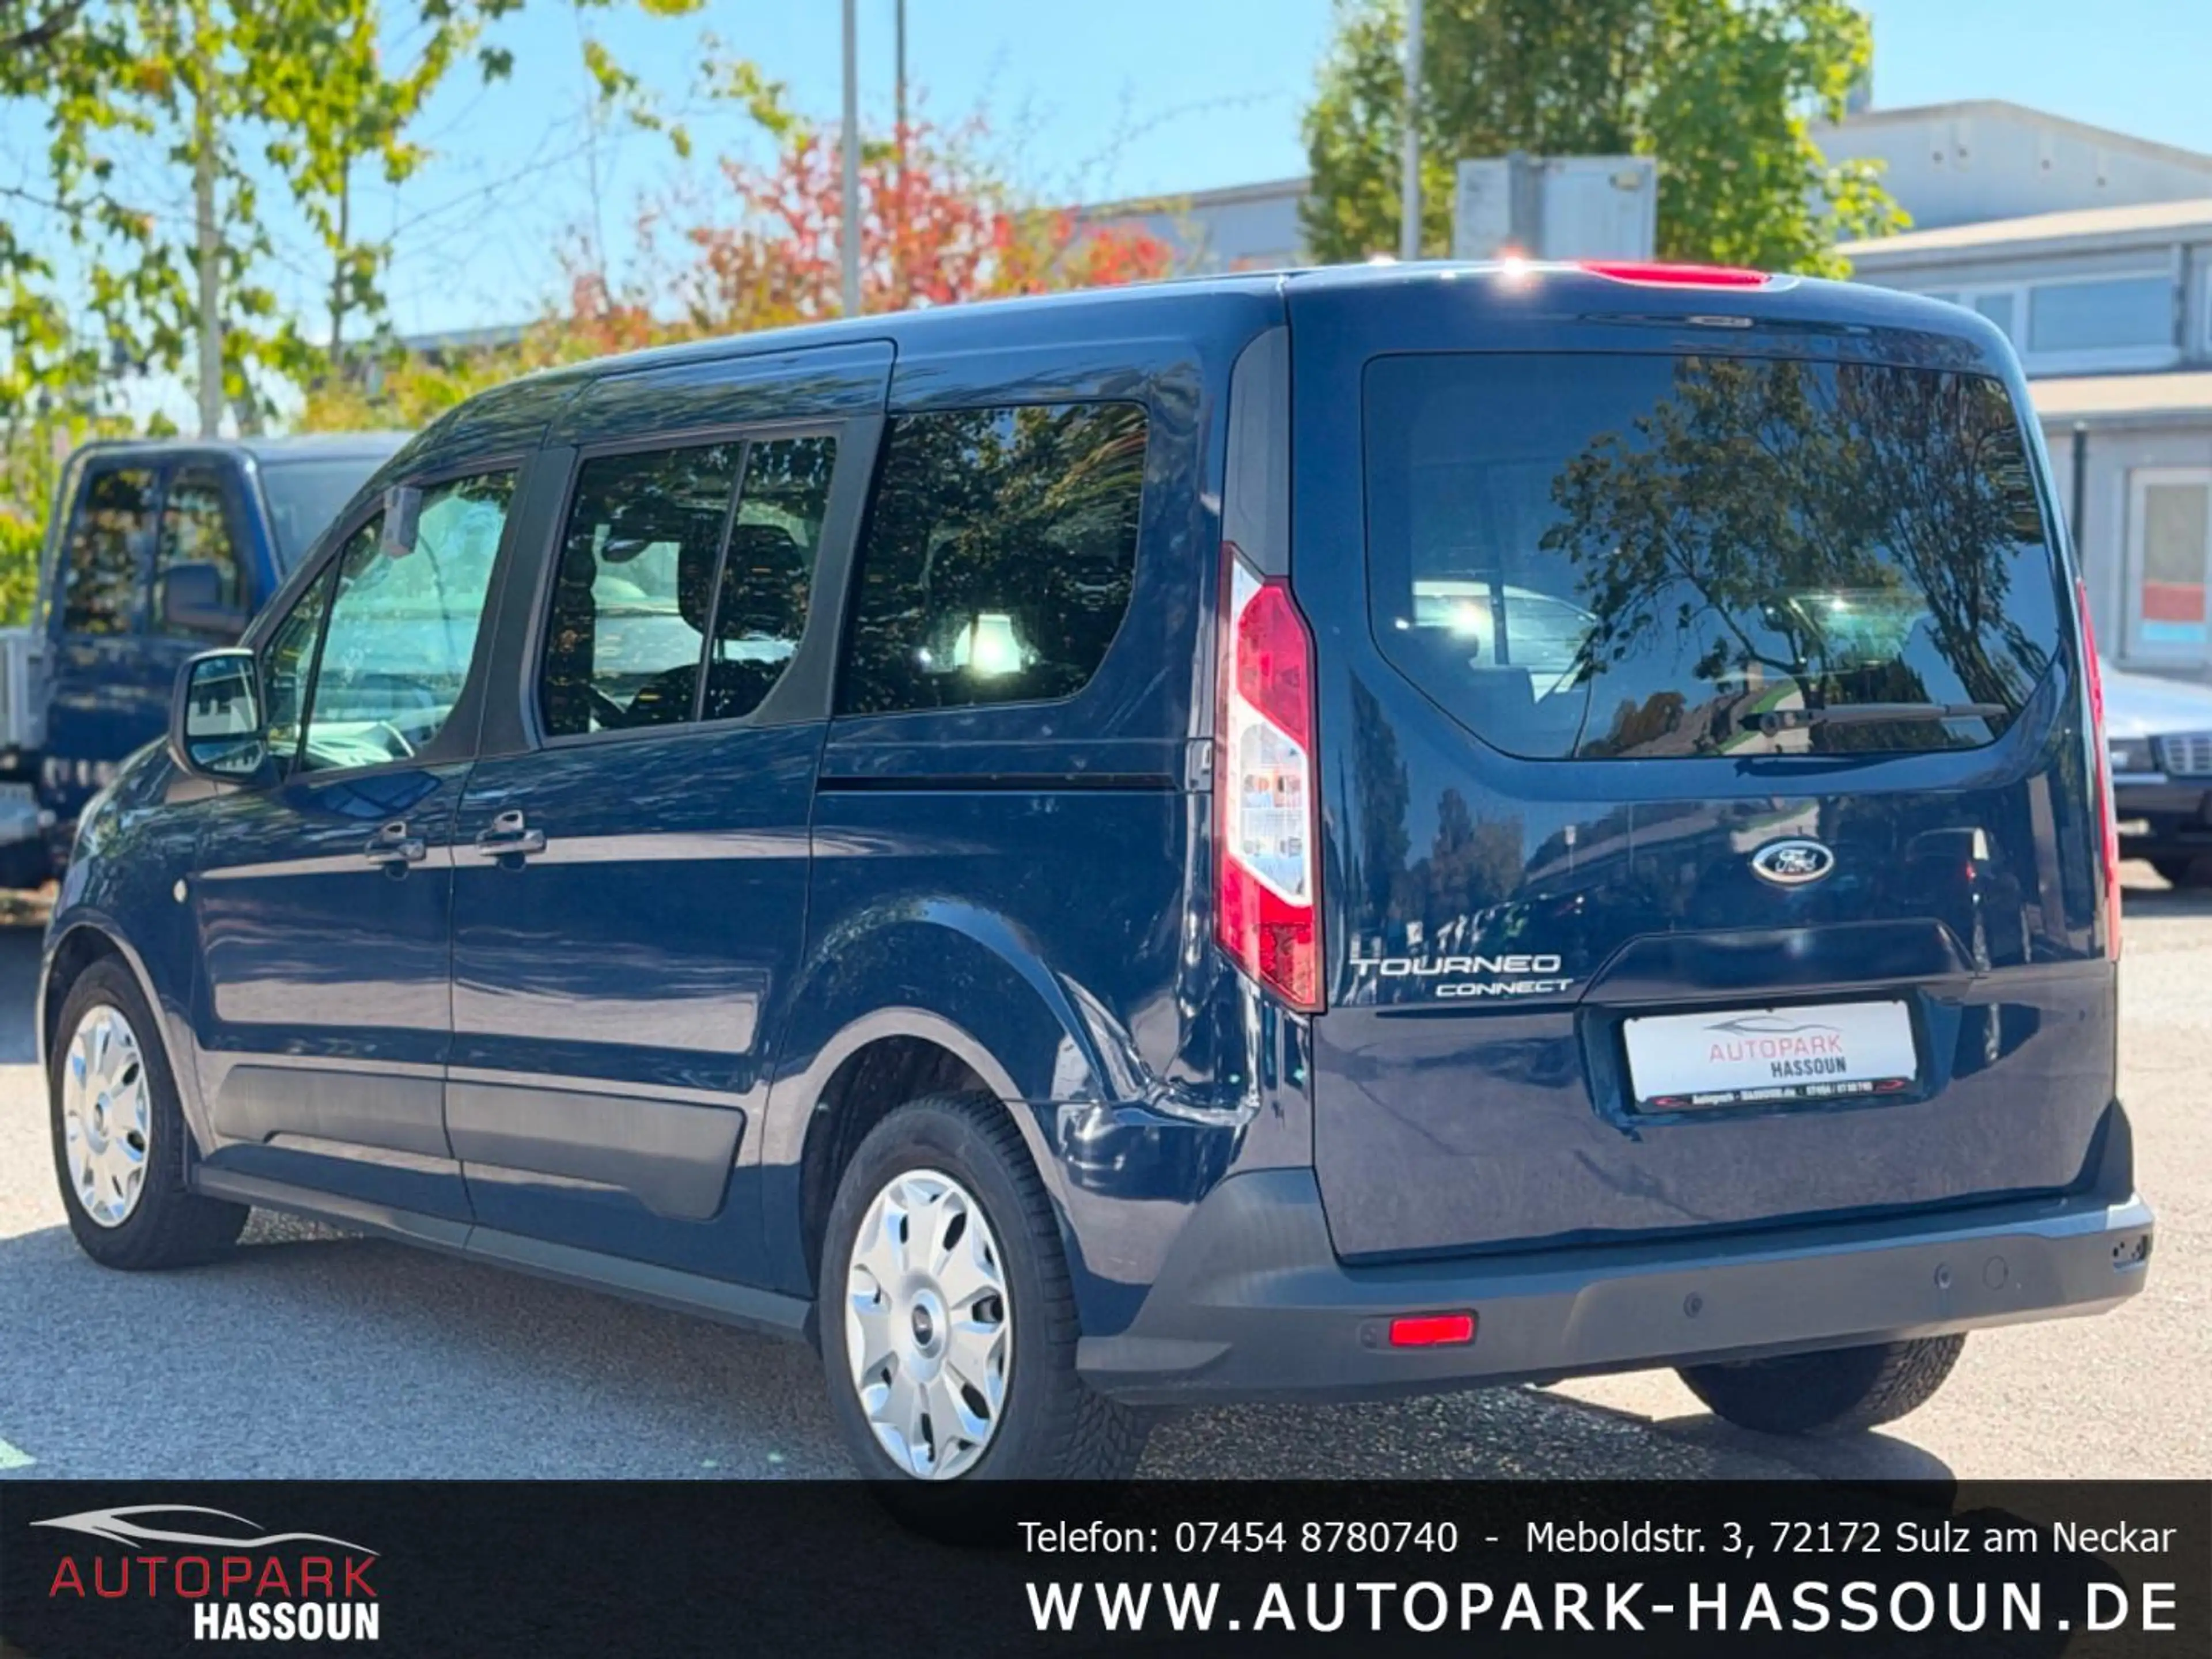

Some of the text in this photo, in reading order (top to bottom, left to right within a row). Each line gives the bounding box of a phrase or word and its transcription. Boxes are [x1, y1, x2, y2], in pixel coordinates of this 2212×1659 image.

[1350, 955, 1562, 976] TOURNEO
[1436, 979, 1574, 997] CONNECT
[1710, 1035, 1842, 1062] AUTOPARK
[1771, 1057, 1846, 1078] HASSOUN
